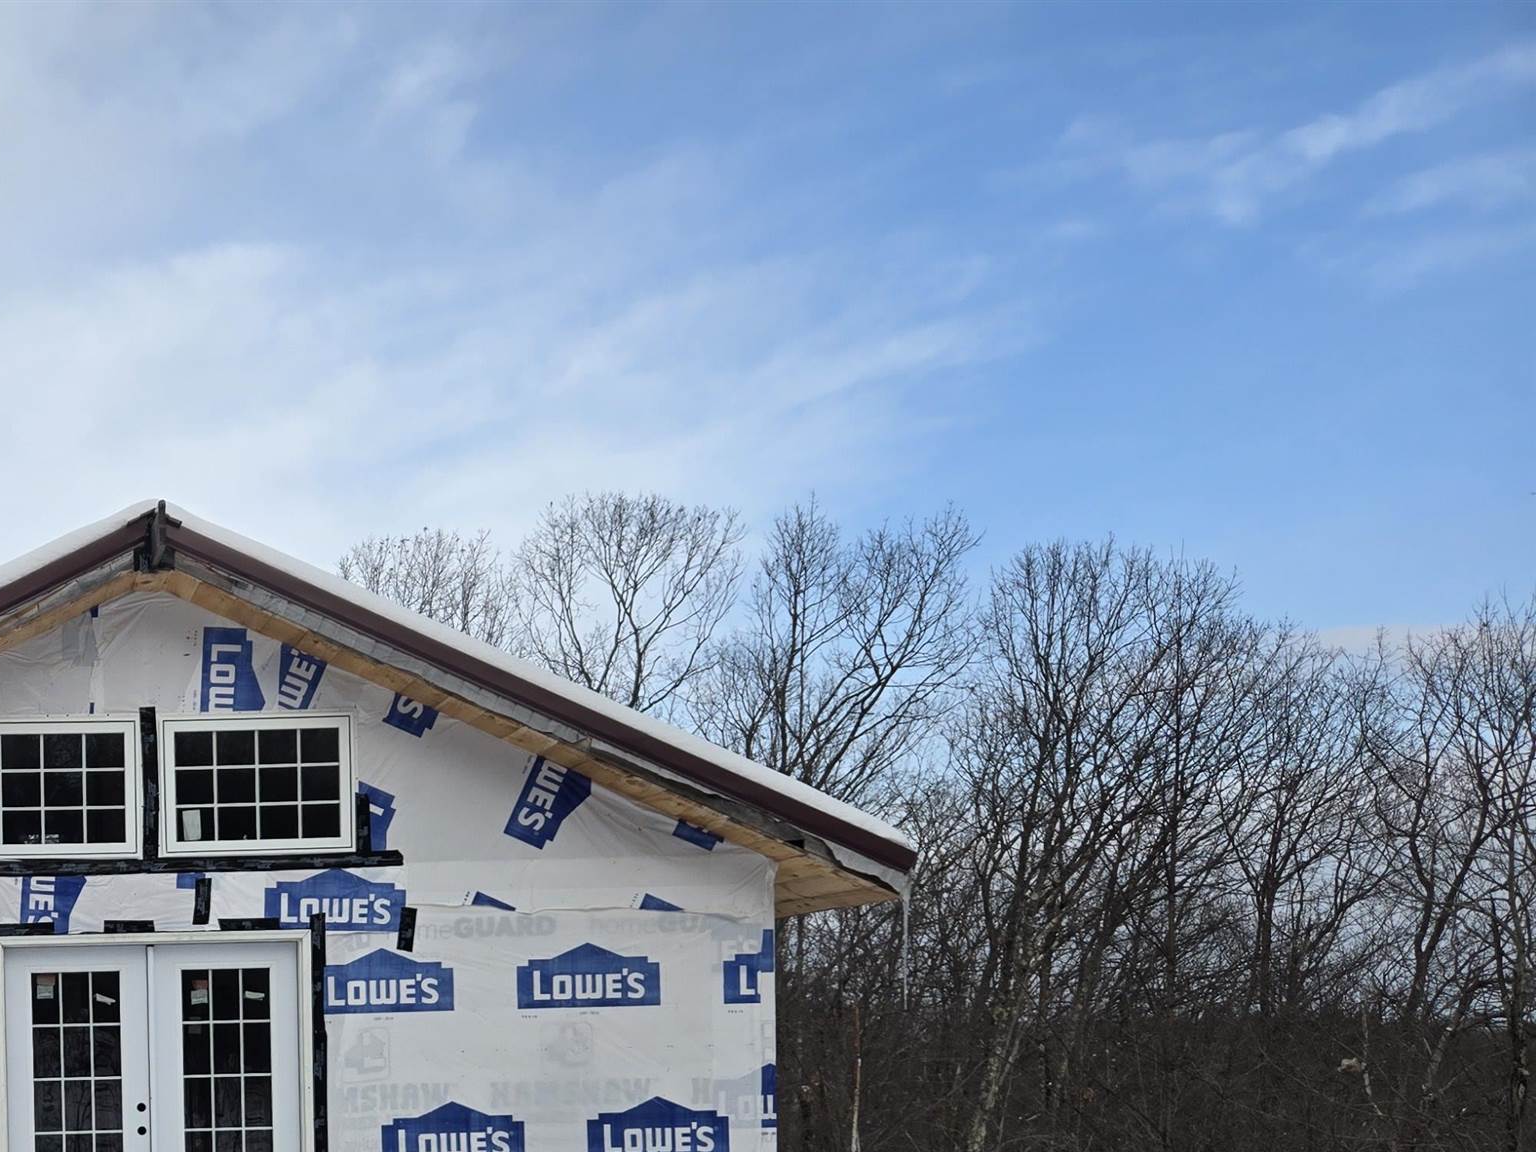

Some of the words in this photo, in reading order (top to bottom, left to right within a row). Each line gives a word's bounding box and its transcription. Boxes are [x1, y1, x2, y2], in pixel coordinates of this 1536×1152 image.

[280, 893, 391, 925] LOWE'S
[327, 973, 440, 1006] LOWE'S
[533, 968, 645, 1000] LOWE'S
